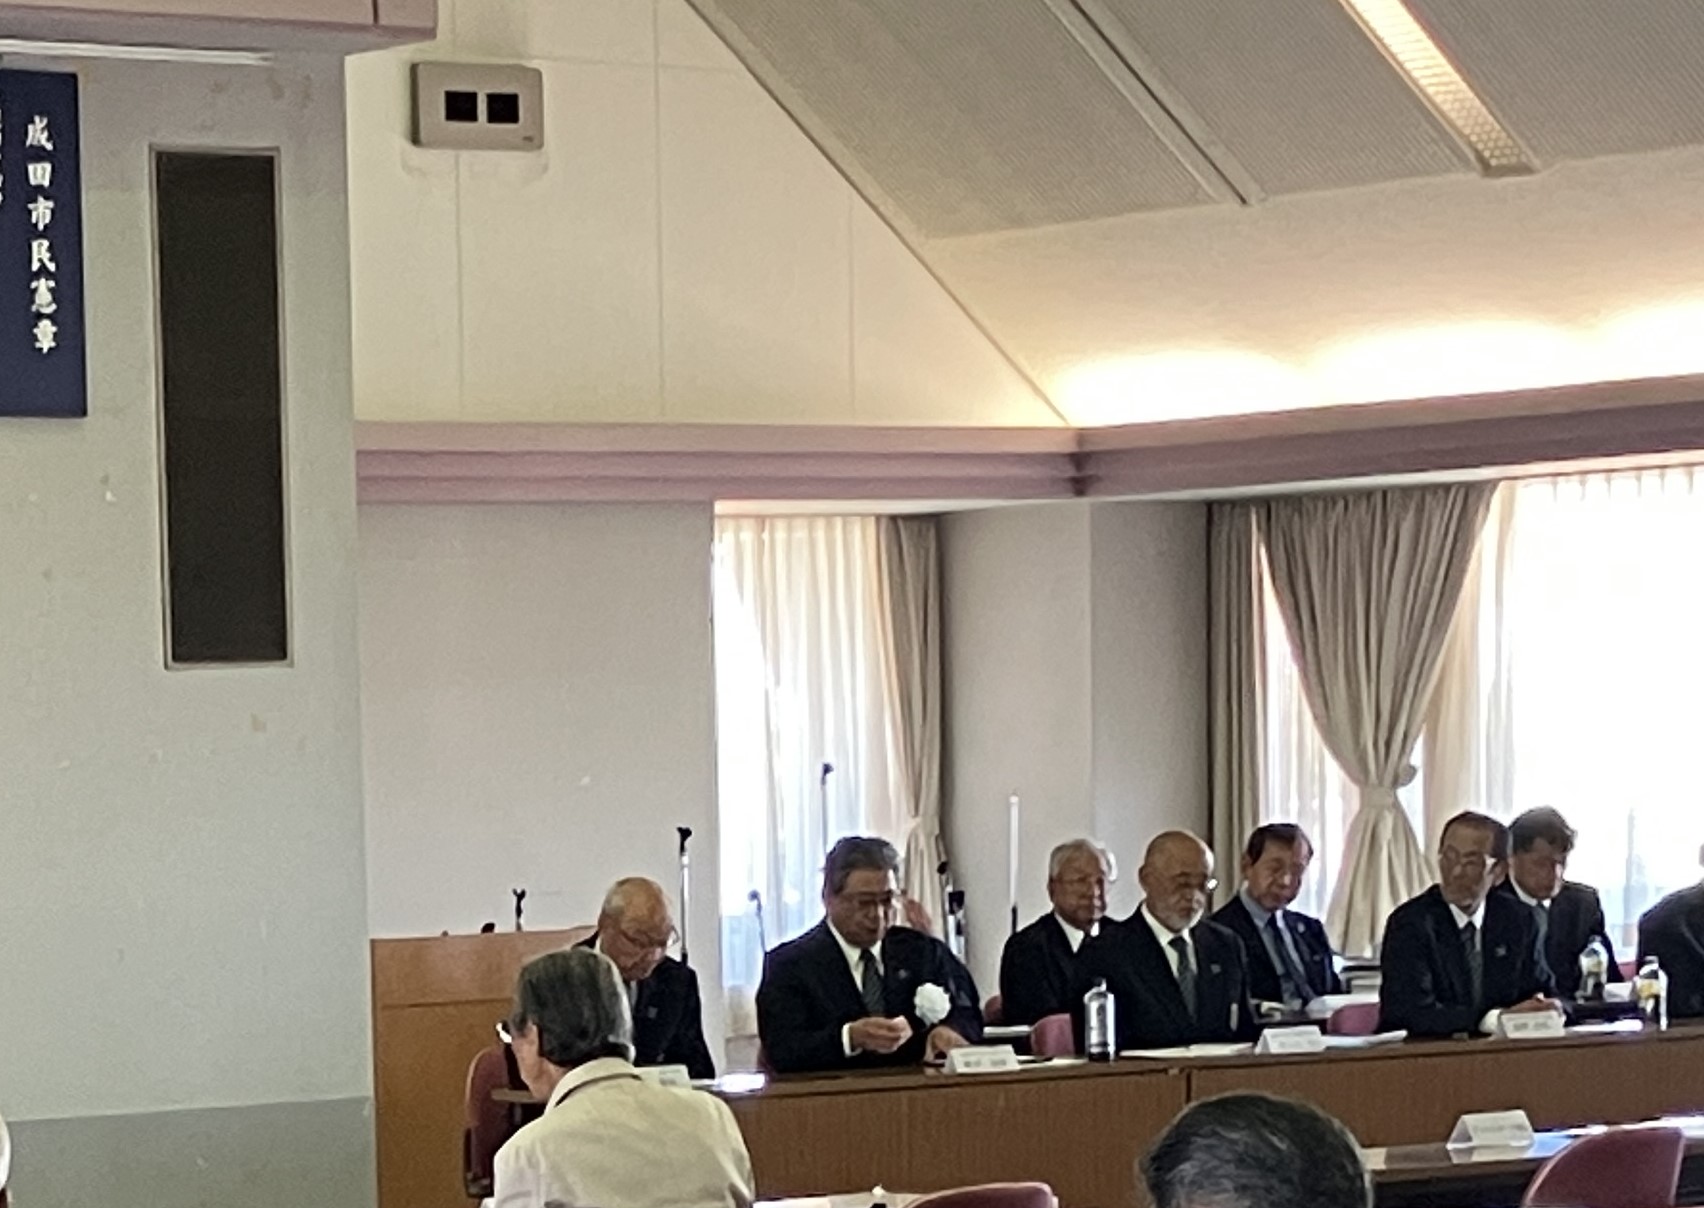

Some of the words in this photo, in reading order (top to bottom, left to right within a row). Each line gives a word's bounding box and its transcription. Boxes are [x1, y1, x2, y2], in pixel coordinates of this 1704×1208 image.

[25, 115, 58, 354] 成田市民憲章
